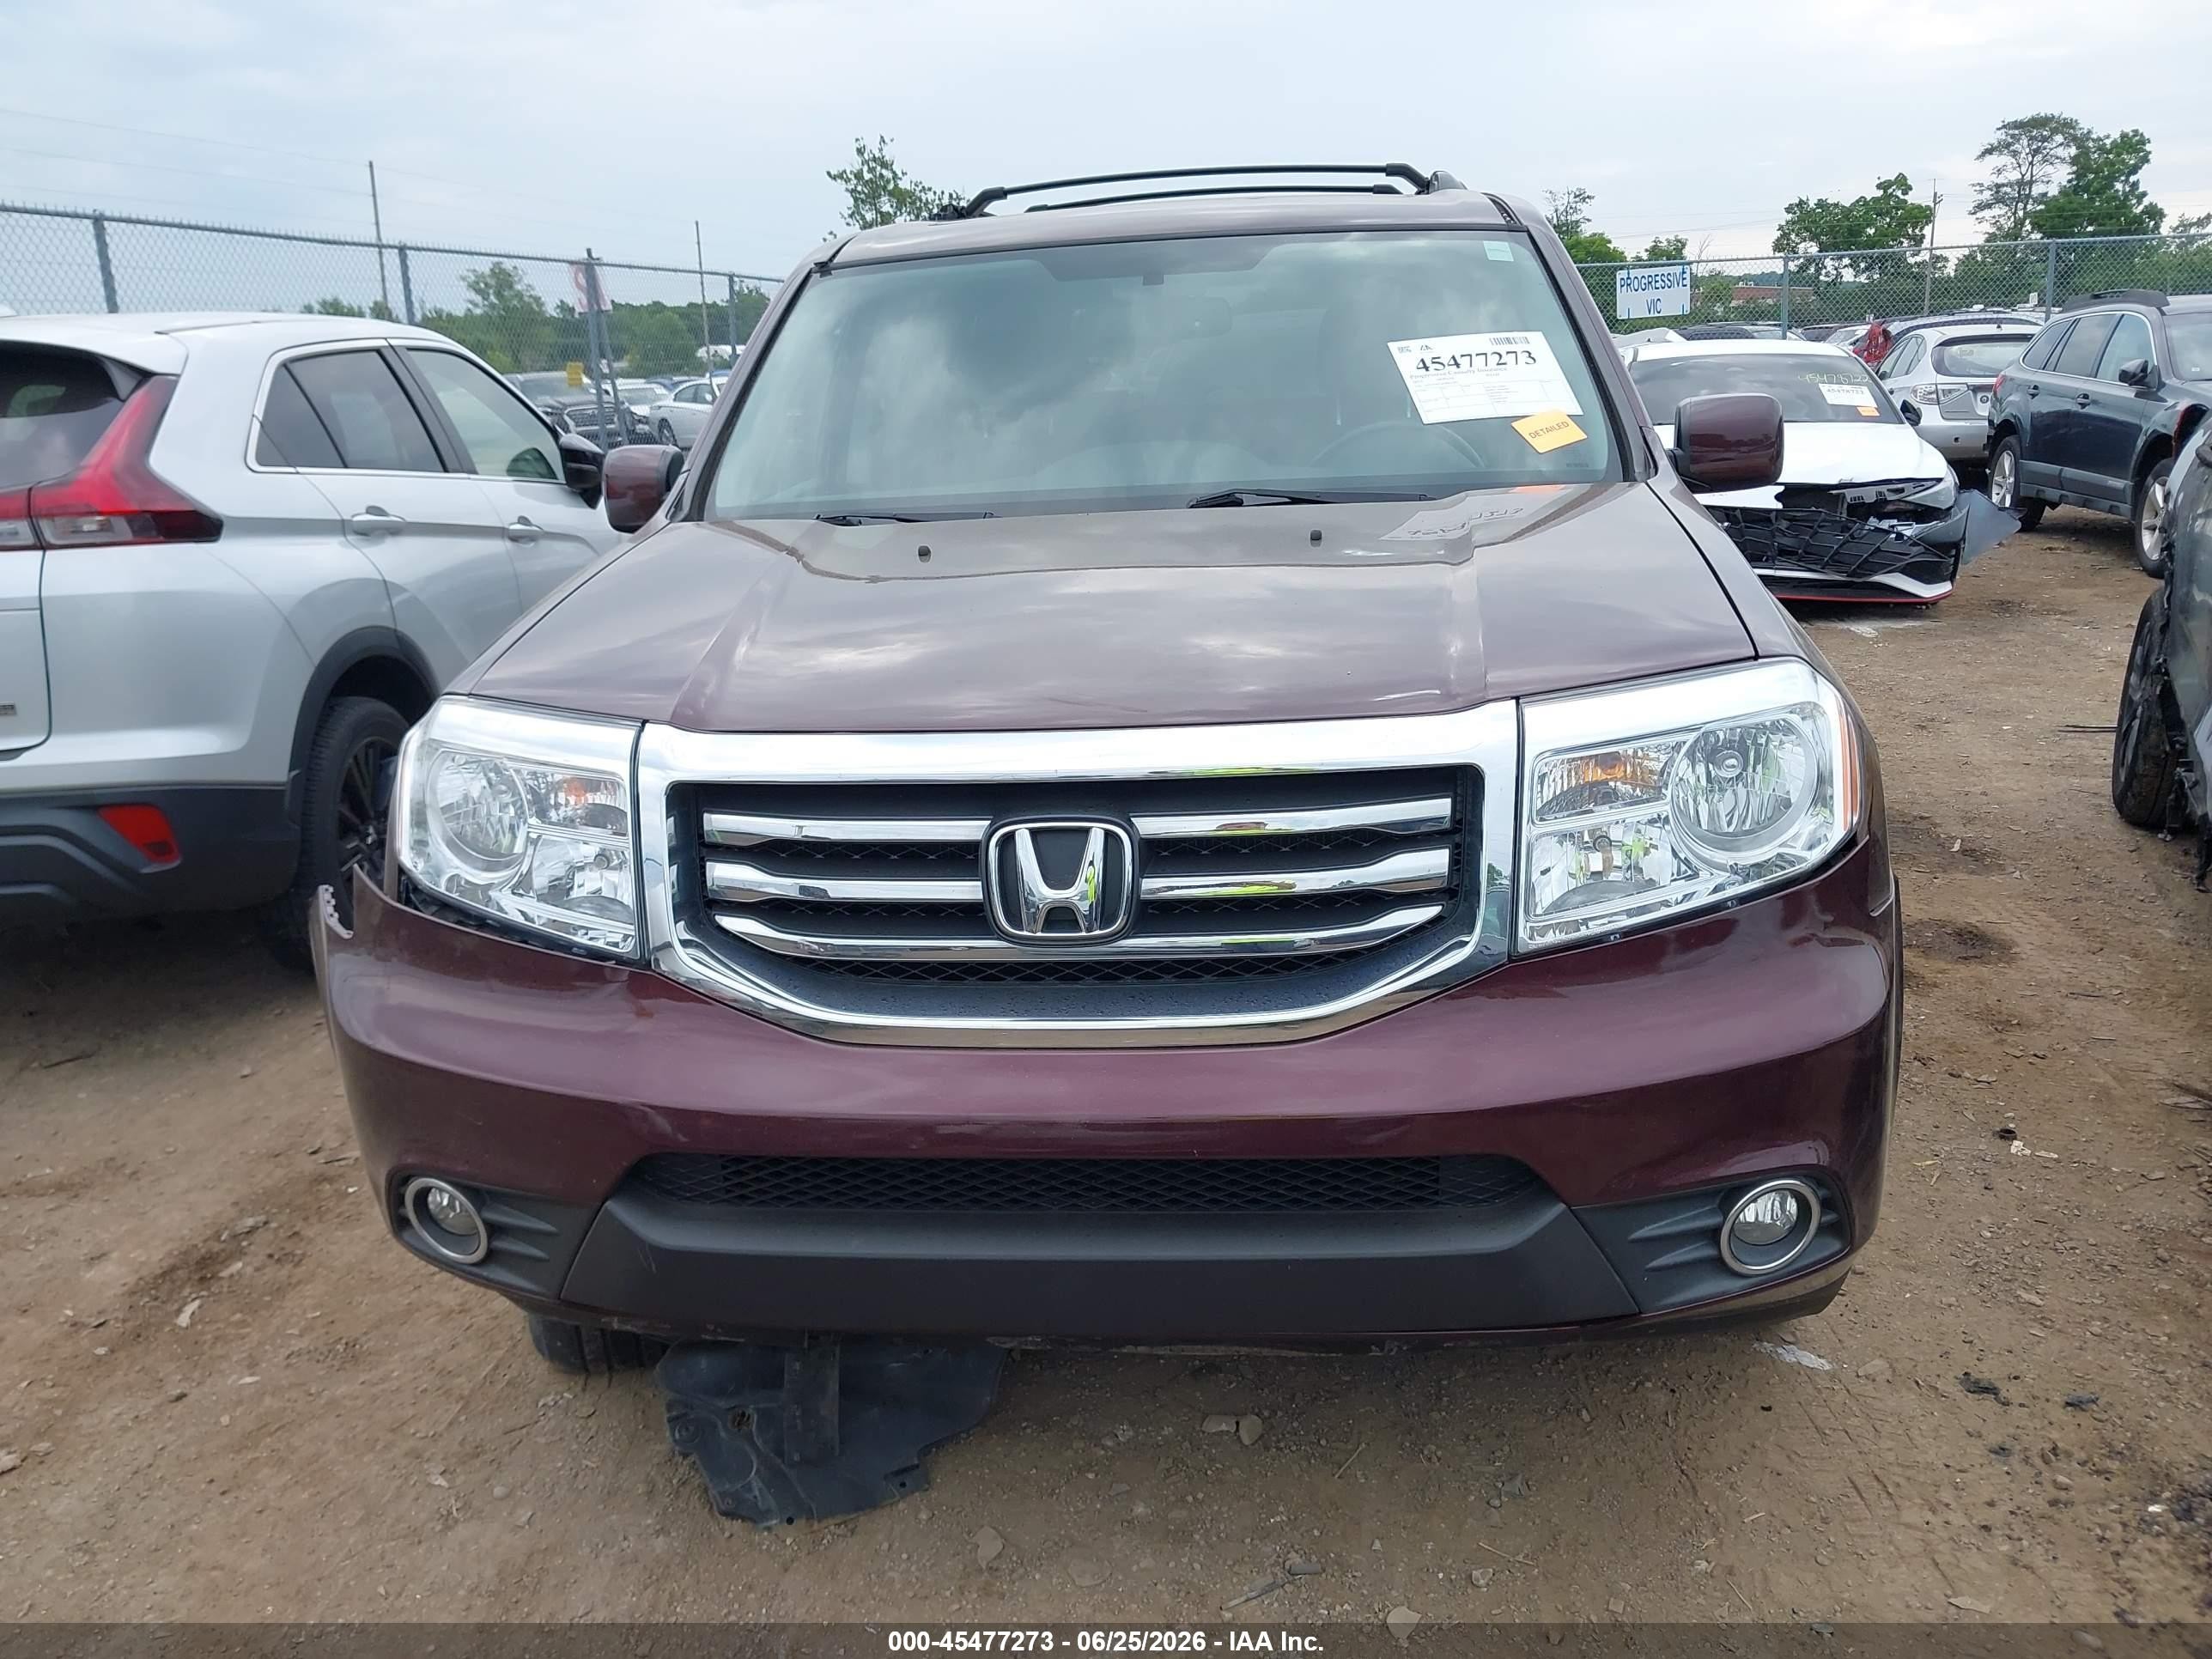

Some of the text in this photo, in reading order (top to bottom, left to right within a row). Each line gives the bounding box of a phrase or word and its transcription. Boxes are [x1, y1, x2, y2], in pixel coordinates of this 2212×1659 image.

[1620, 270, 1688, 294] PROGRESSIVE
[1645, 298, 1663, 315] VIC
[1416, 349, 1537, 372] 45477273
[1528, 420, 1571, 440] DETAILED
